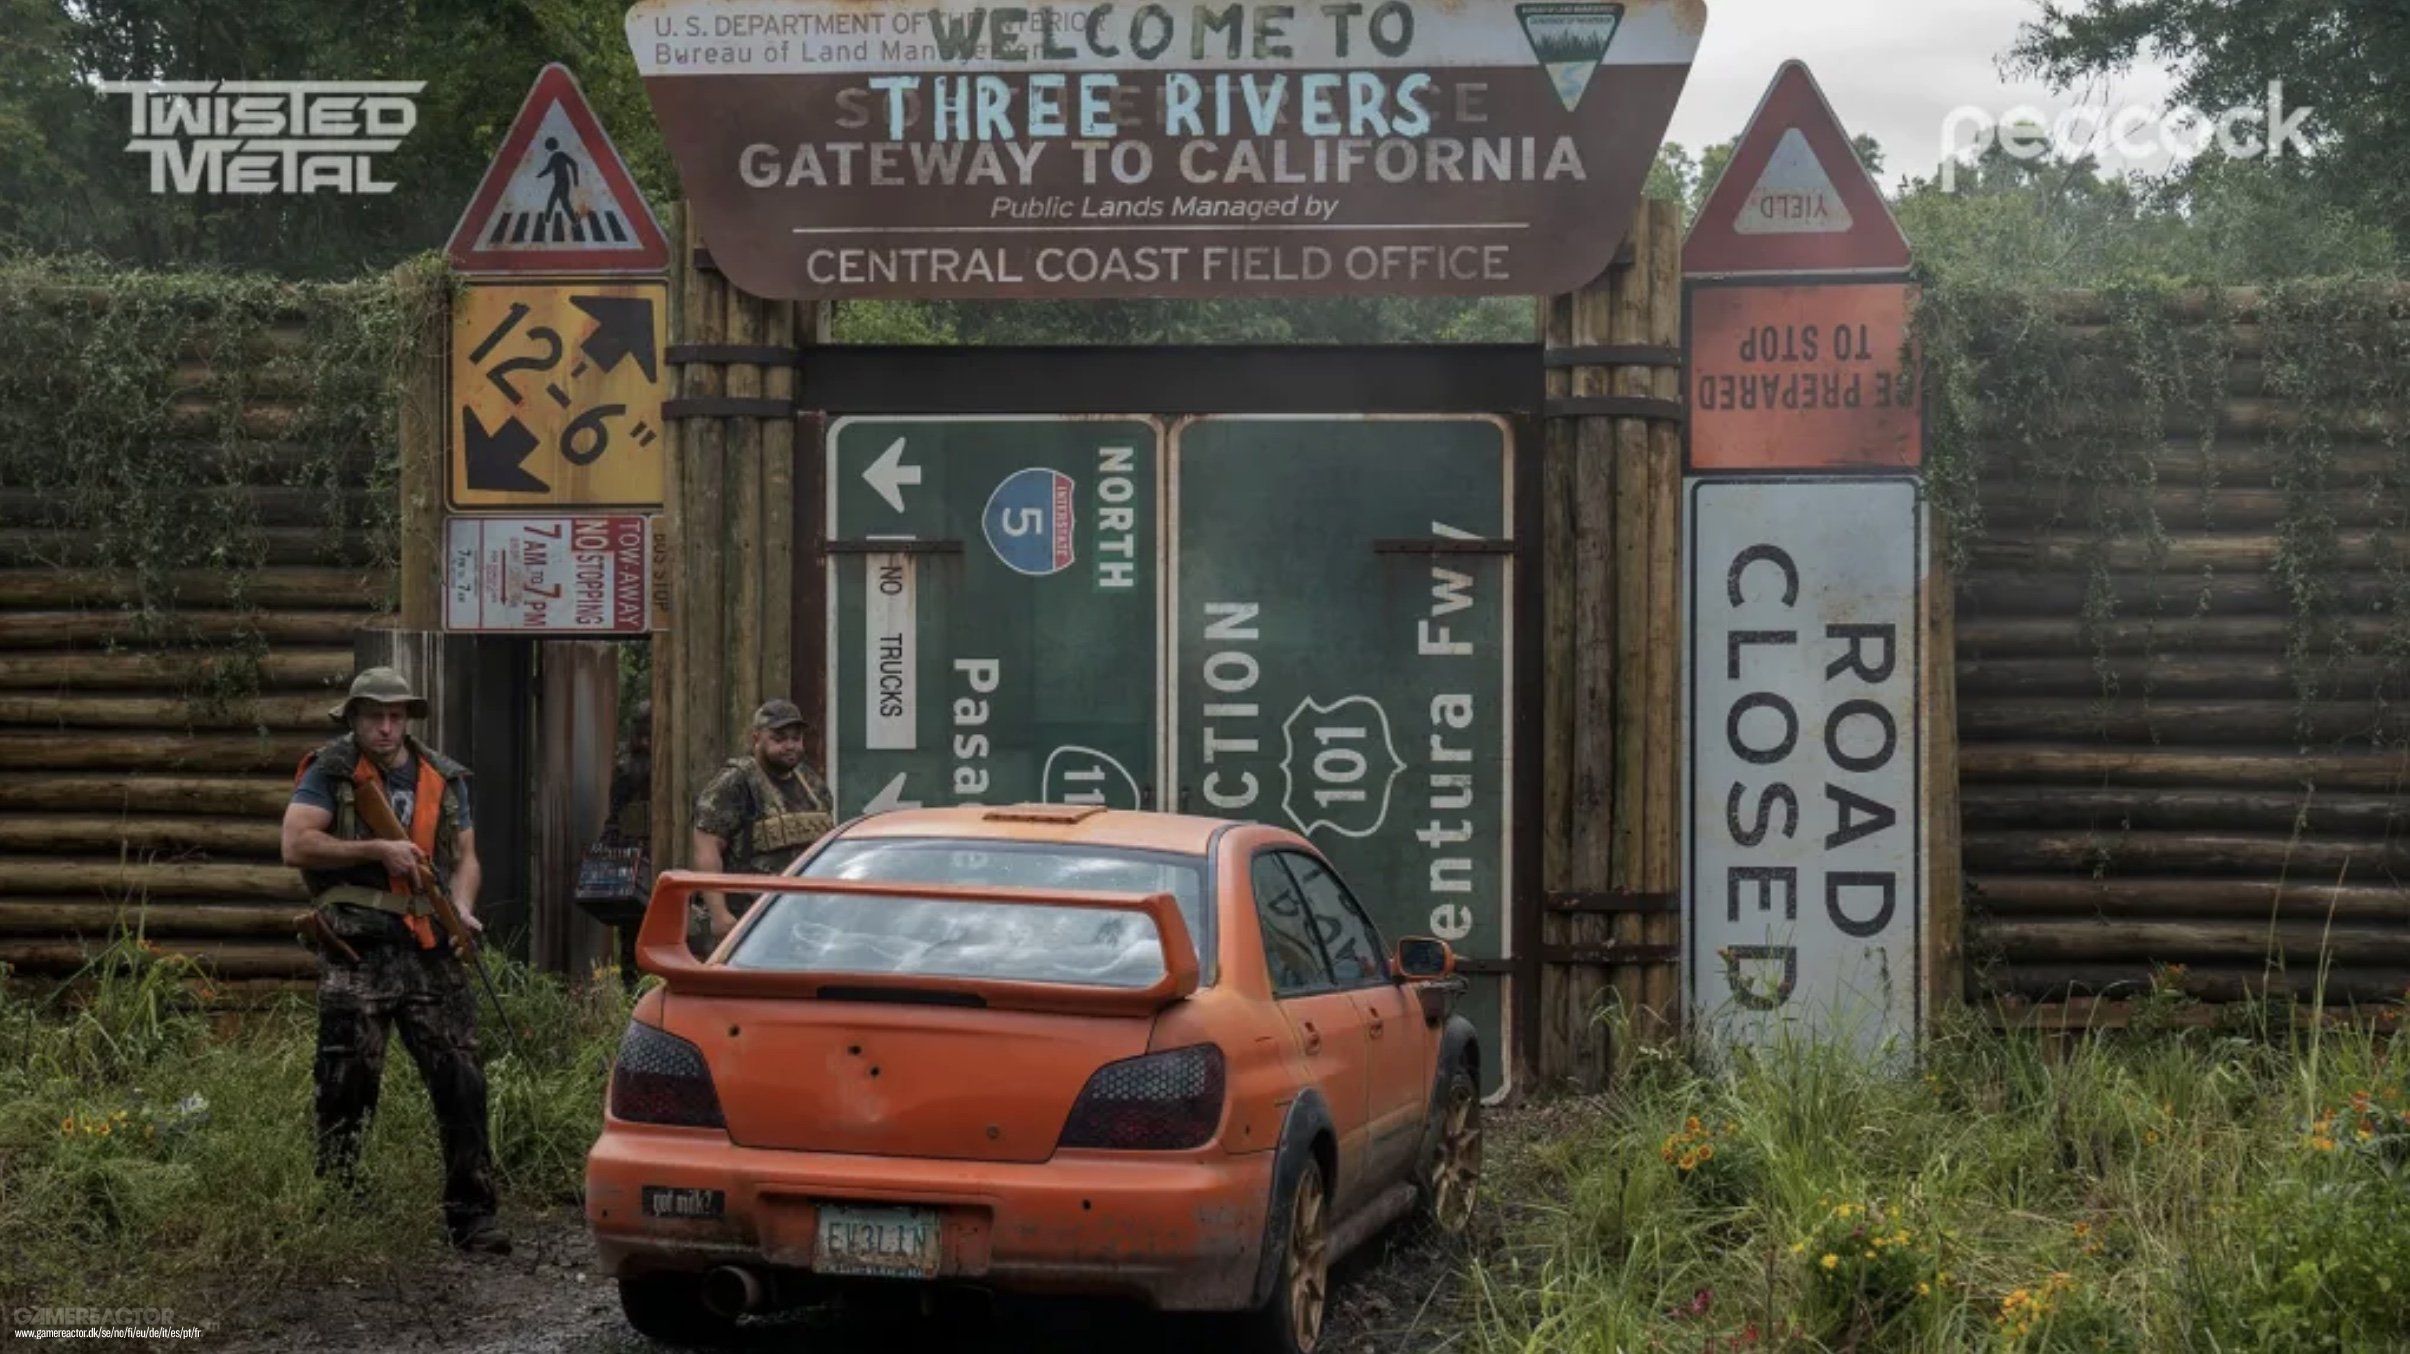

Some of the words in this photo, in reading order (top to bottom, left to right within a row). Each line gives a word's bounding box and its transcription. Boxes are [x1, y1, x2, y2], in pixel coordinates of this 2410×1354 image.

[714, 13, 885, 36] DEPARTMENT
[892, 12, 923, 34] OF
[926, 3, 1294, 62] WELCOME
[1322, 2, 1414, 58] TO
[654, 42, 752, 65] Bureau
[763, 41, 790, 63] of
[801, 40, 868, 63] Land
[869, 73, 1119, 141] THREE
[1165, 71, 1432, 138] RIVERS
[738, 141, 1047, 188] GATEWAY
[1071, 139, 1153, 184] TO
[1179, 135, 1587, 184] CALIFORNIA
[990, 197, 1073, 219] Public
[1081, 196, 1163, 218] Lands
[1171, 194, 1298, 220] Managed
[1304, 196, 1339, 221] by
[1760, 194, 1828, 219] YIELD
[806, 248, 1023, 283] CENTRAL
[1035, 246, 1189, 282] COAST
[1203, 246, 1332, 281] FIELD
[1345, 245, 1510, 281] OFFICE
[1739, 324, 1819, 363] STOP
[1834, 324, 1872, 361] TO
[1698, 372, 1862, 411] PREPARED
[575, 519, 609, 550] NO
[1002, 507, 1043, 537] 5
[1055, 485, 1069, 557] INTERSTATE
[1098, 447, 1135, 588] NORTH
[576, 554, 605, 625] STOPPING
[618, 521, 641, 626] TOW-AWAY
[652, 570, 671, 612] STOP
[879, 566, 903, 596] NO
[879, 633, 903, 718] TRUCKS
[953, 658, 1000, 806] Pasa
[1203, 602, 1260, 823] CTION
[1313, 727, 1368, 808] 101
[1726, 542, 1800, 1012] CLOSED
[1824, 623, 1898, 938] ROAD
[1416, 693, 1474, 941] entura
